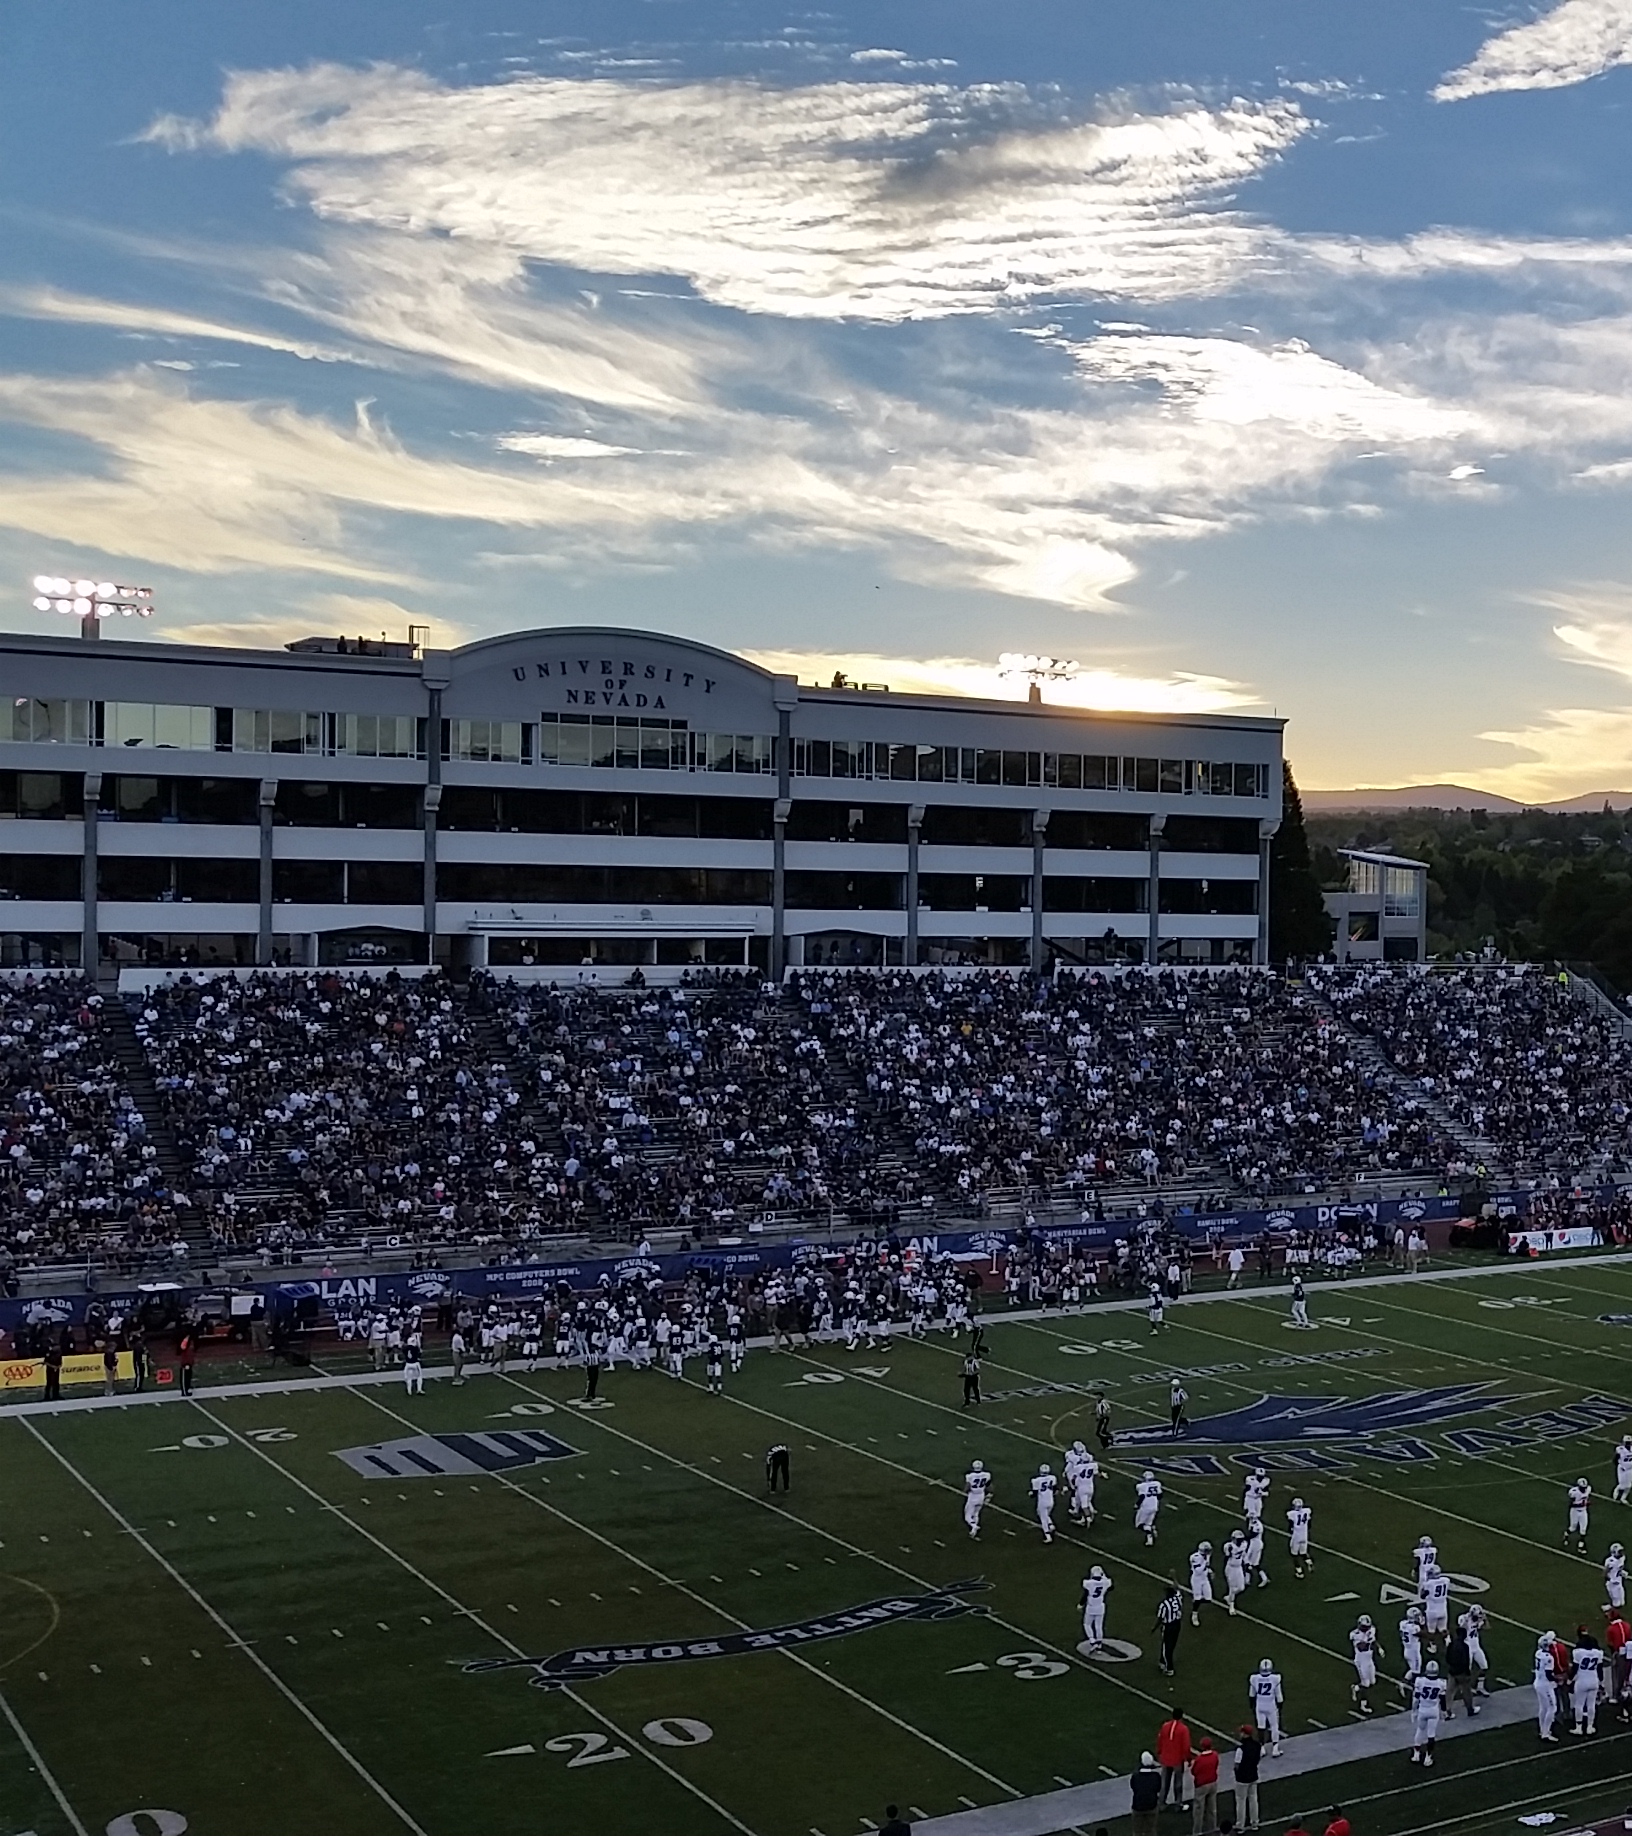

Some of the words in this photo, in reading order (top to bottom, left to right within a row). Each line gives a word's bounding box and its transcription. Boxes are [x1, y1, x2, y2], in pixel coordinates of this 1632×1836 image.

[512, 659, 716, 695] UNIVERSITY
[605, 679, 627, 690] OF
[566, 689, 667, 709] NEVADA
[388, 1237, 398, 1247] C
[61, 1363, 101, 1374] surance
[1423, 1553, 1436, 1566] 19
[1434, 1583, 1447, 1599] 91
[748, 1599, 920, 1649] BATTLE
[571, 1641, 725, 1665] BORN
[995, 1637, 1143, 1680] 30
[1580, 1656, 1599, 1671] 92
[1257, 1682, 1272, 1697] 12
[1422, 1685, 1440, 1701] 58
[545, 1717, 714, 1769] 20
